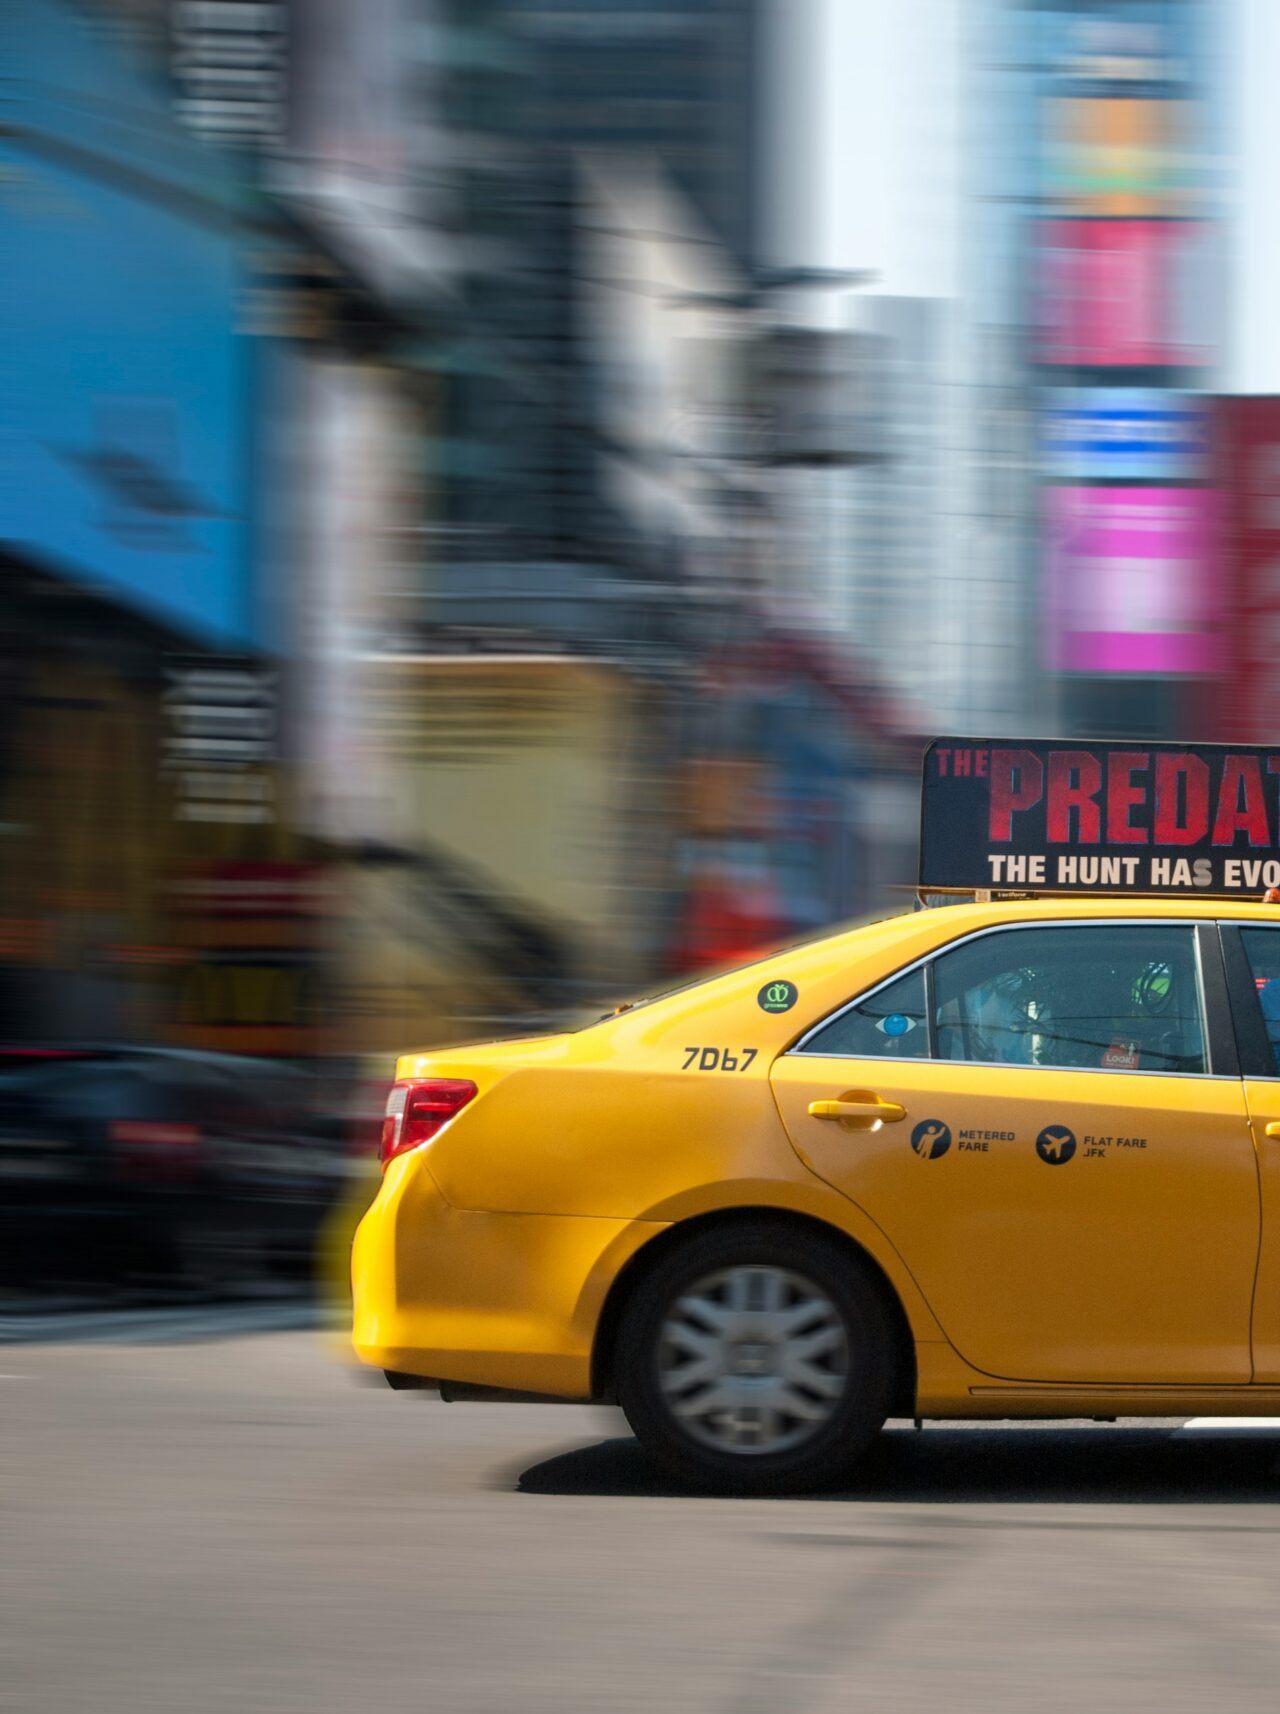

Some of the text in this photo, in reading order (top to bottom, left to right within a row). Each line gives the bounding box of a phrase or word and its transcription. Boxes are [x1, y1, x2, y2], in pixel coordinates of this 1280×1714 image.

[936, 749, 988, 777] THE
[988, 855, 1046, 883] THE
[1057, 856, 1140, 885] HUNT
[1151, 858, 1213, 887] HAS
[959, 1129, 1016, 1142] METERED
[958, 1142, 989, 1152] FARE
[1084, 1136, 1148, 1149] FLAT FARE
[1083, 1148, 1106, 1158] JFK
